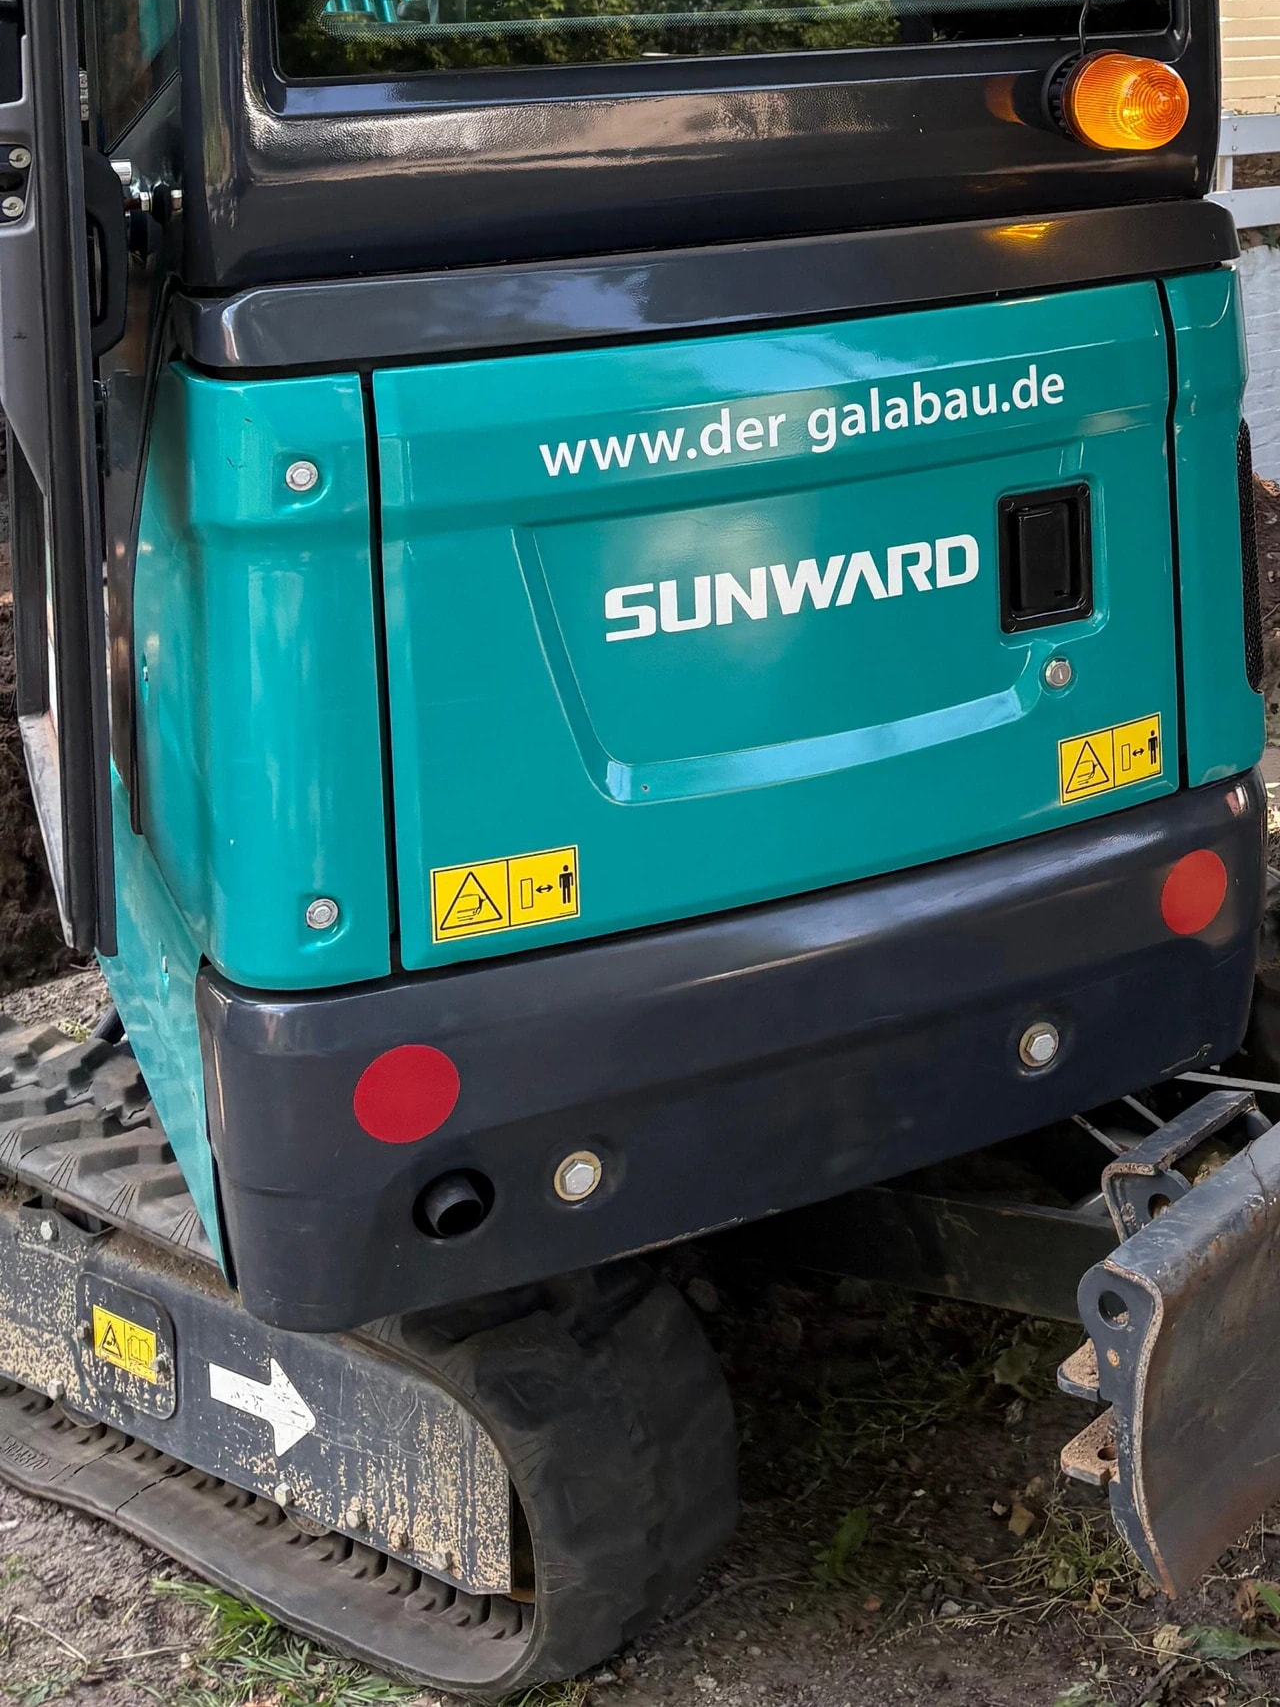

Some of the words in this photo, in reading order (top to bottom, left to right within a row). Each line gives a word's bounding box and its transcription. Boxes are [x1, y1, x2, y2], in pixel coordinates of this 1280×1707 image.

[539, 408, 786, 477] www.der
[807, 364, 1065, 454] galabau.de
[604, 533, 980, 643] SUNWARD
